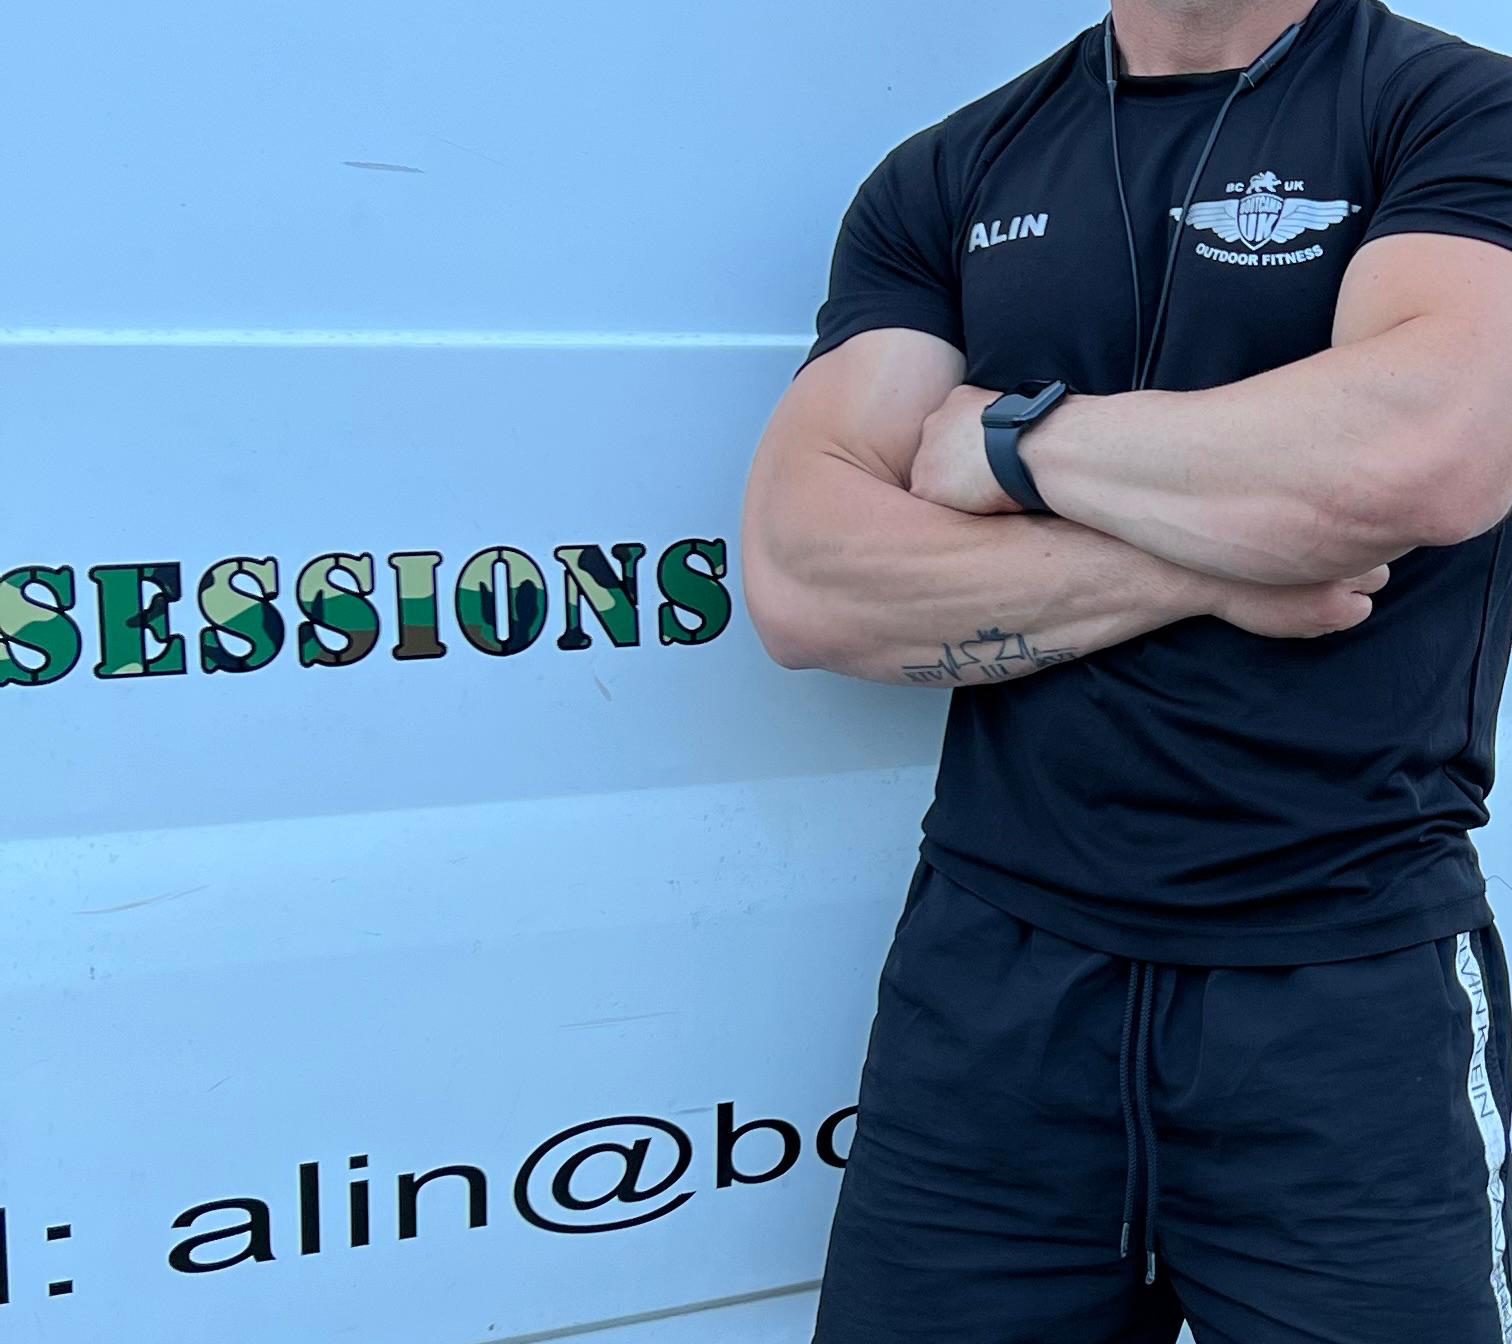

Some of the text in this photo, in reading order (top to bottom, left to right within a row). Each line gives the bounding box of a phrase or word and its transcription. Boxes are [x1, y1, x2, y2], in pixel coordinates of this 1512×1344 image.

[1226, 180, 1305, 194] BC UK
[968, 212, 1049, 253] ALIN
[1239, 213, 1279, 242] UK
[1195, 242, 1324, 267] OUTDOOR FITNESS
[0, 537, 732, 688] SESSIONS
